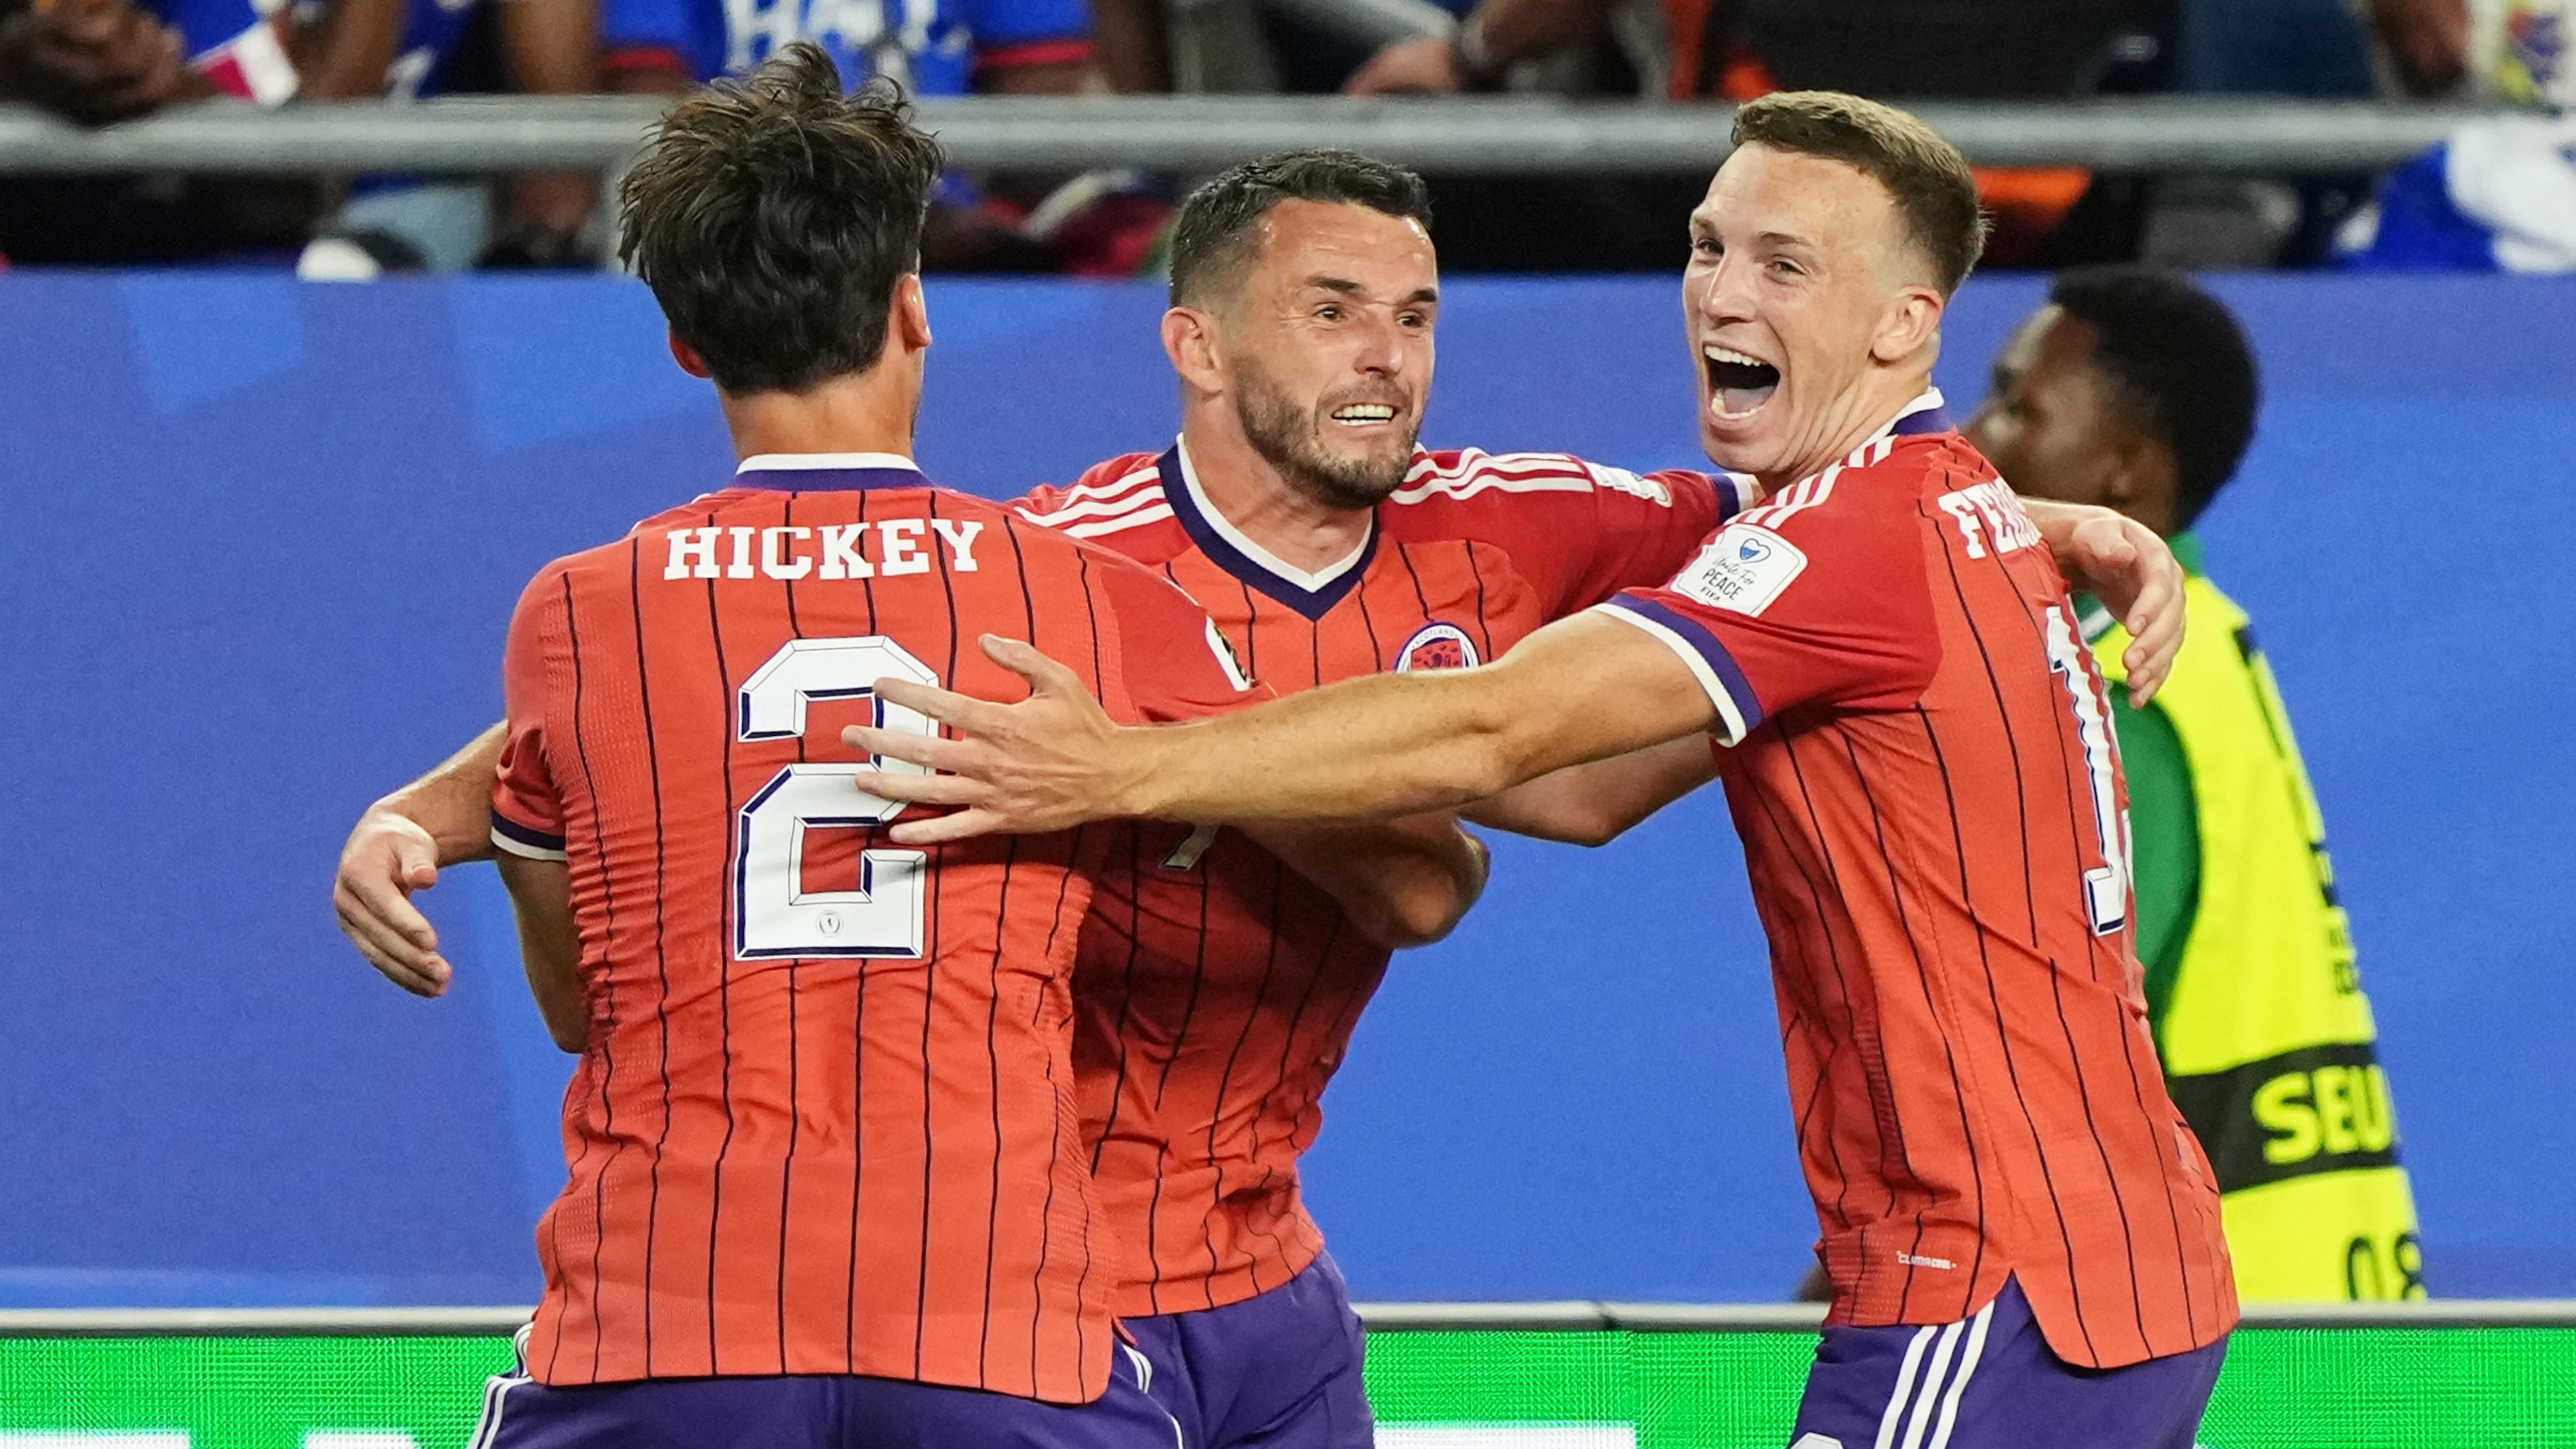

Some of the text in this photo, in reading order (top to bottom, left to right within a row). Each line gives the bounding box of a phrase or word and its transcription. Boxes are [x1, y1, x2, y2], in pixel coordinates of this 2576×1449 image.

[663, 519, 983, 580] HICKEY
[1701, 568, 1744, 600] PEACE
[1701, 586, 1720, 601] FIFA
[734, 635, 939, 961] 2
